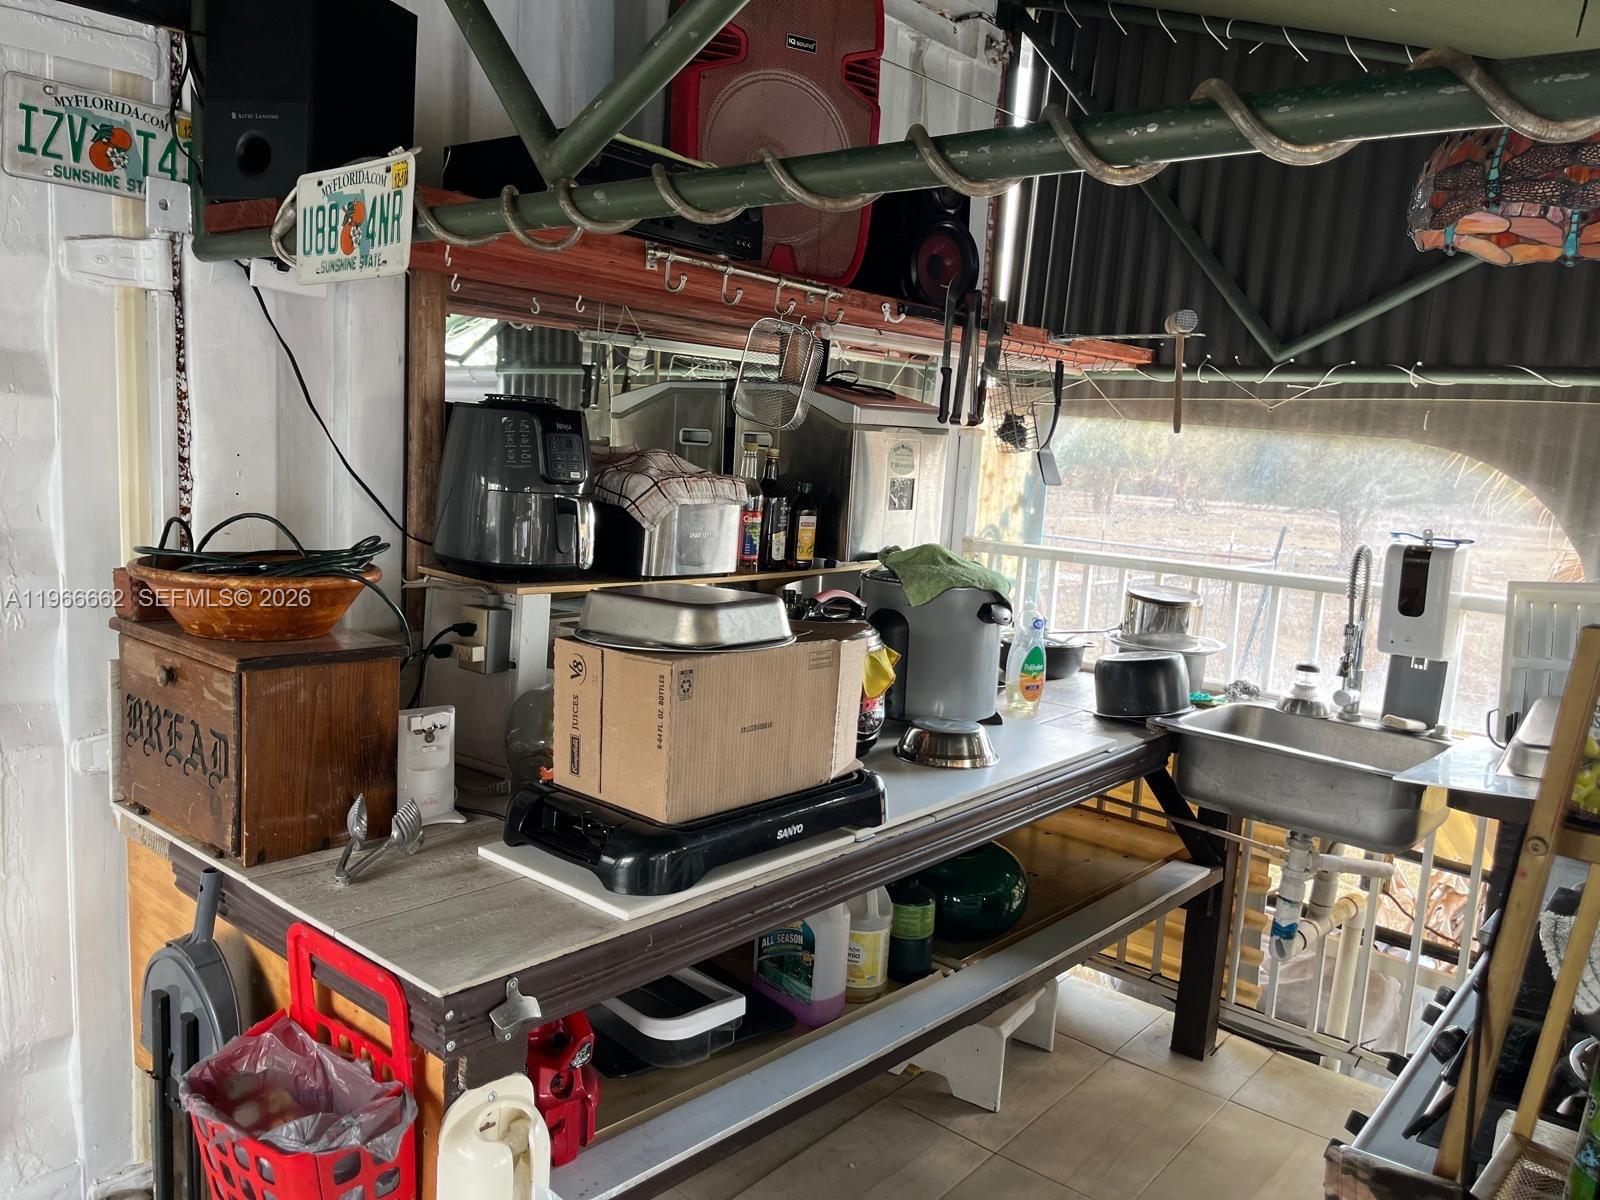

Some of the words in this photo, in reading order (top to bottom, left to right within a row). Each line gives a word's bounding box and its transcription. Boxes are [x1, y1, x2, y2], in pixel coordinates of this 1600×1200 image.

[54, 95, 169, 132] MYFLORIDA.COM
[17, 102, 88, 163] IZV
[53, 164, 120, 190] SUNSHINE
[126, 178, 146, 194] ST
[321, 169, 388, 199] MYFLORIDA.COM
[365, 189, 404, 250] 4NR
[320, 256, 357, 275] SUNSHINE
[359, 252, 383, 271] STATE
[569, 660, 584, 680] V8
[126, 693, 230, 791] BREAD
[776, 823, 804, 840] SANYO
[761, 937, 774, 949] ALL
[777, 933, 804, 945] SEASON
